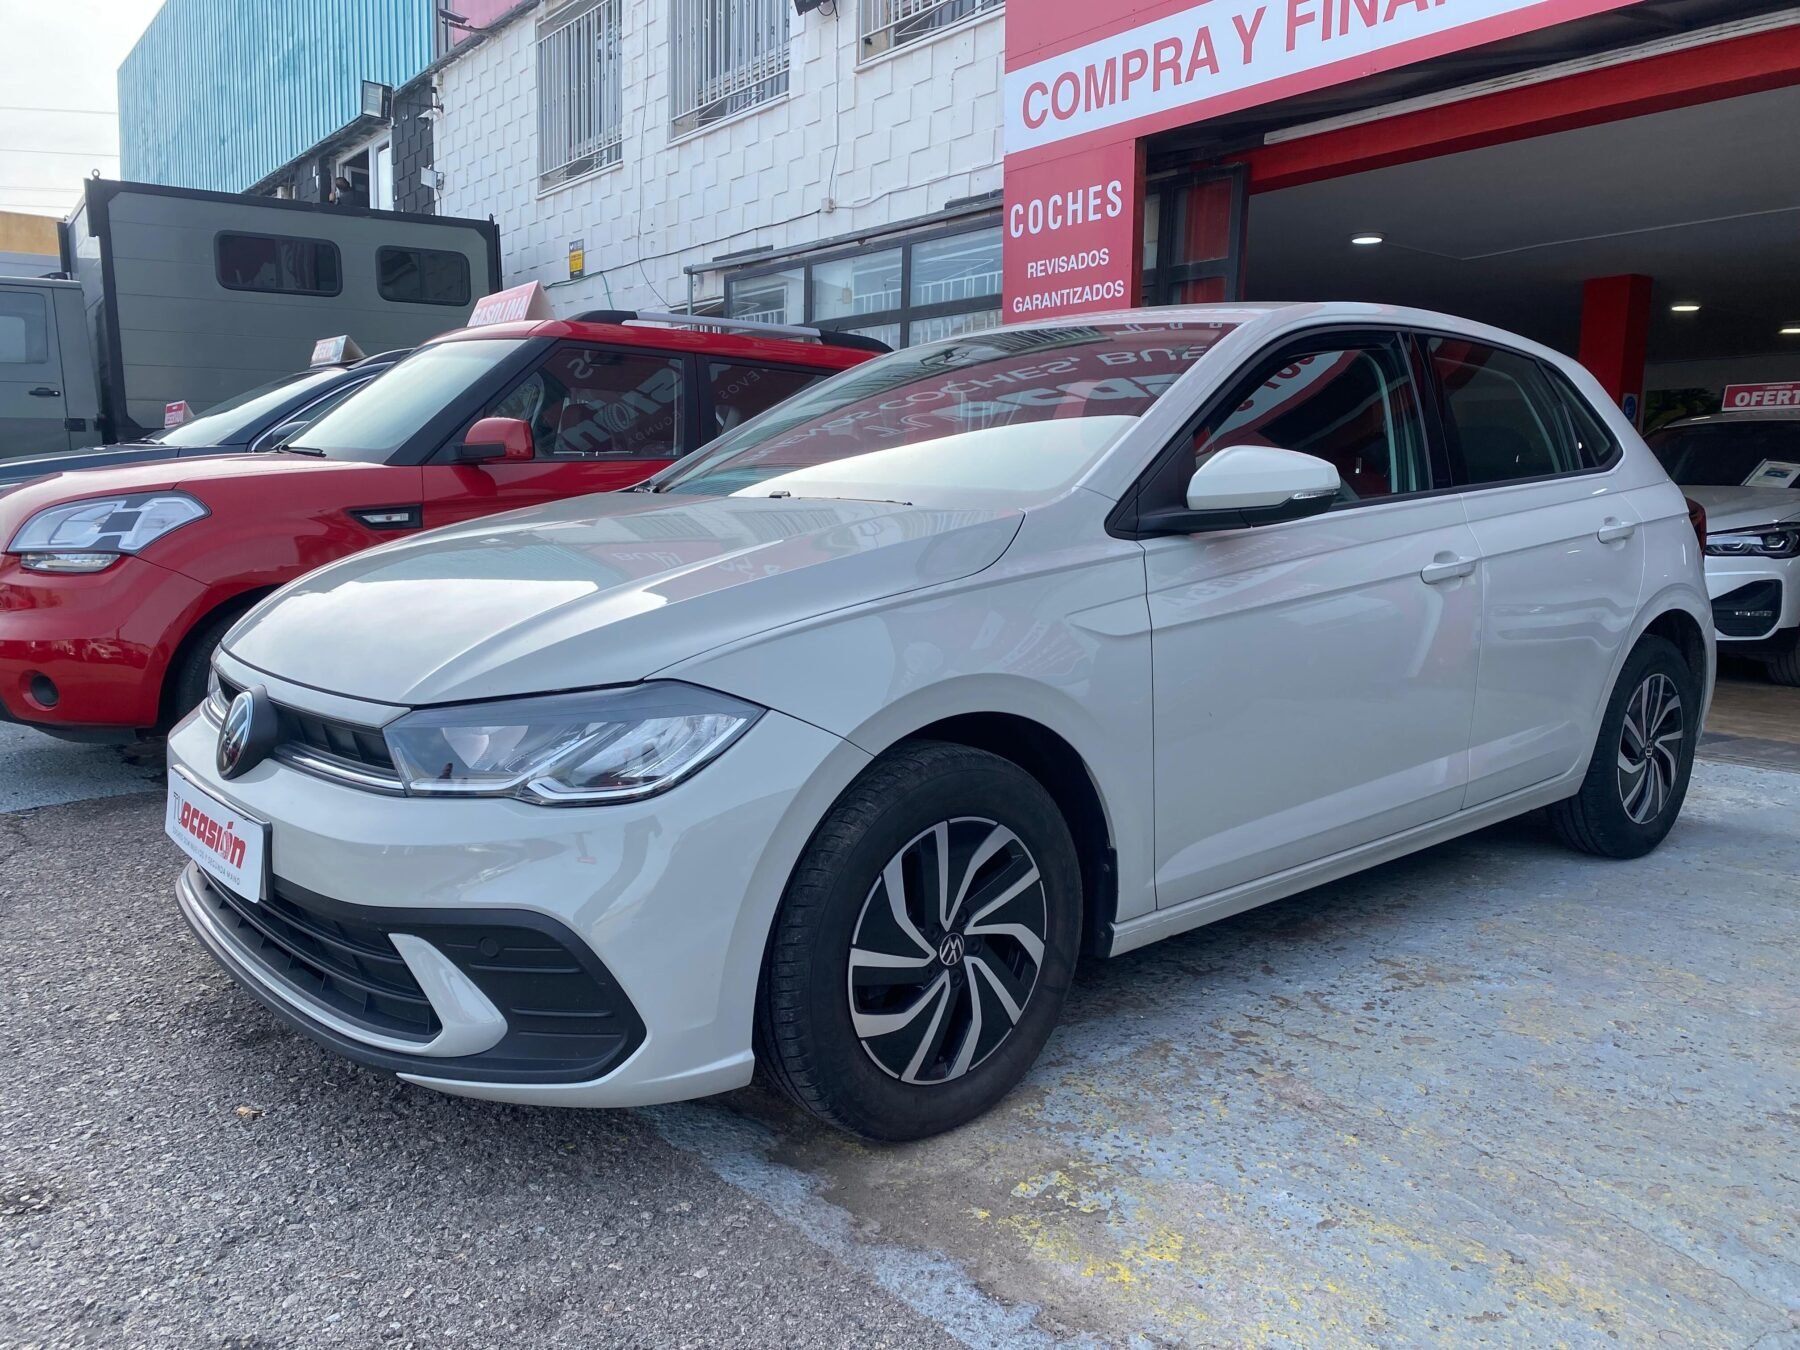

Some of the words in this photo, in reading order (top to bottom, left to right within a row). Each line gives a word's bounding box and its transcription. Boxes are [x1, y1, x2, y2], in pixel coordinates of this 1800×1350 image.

[1022, 25, 1220, 130] COMPRA
[1231, 5, 1267, 65] Y
[1010, 180, 1122, 238] COCHES
[1027, 247, 1110, 279] REVISADOS
[1013, 279, 1125, 313] GARANTIZADOS
